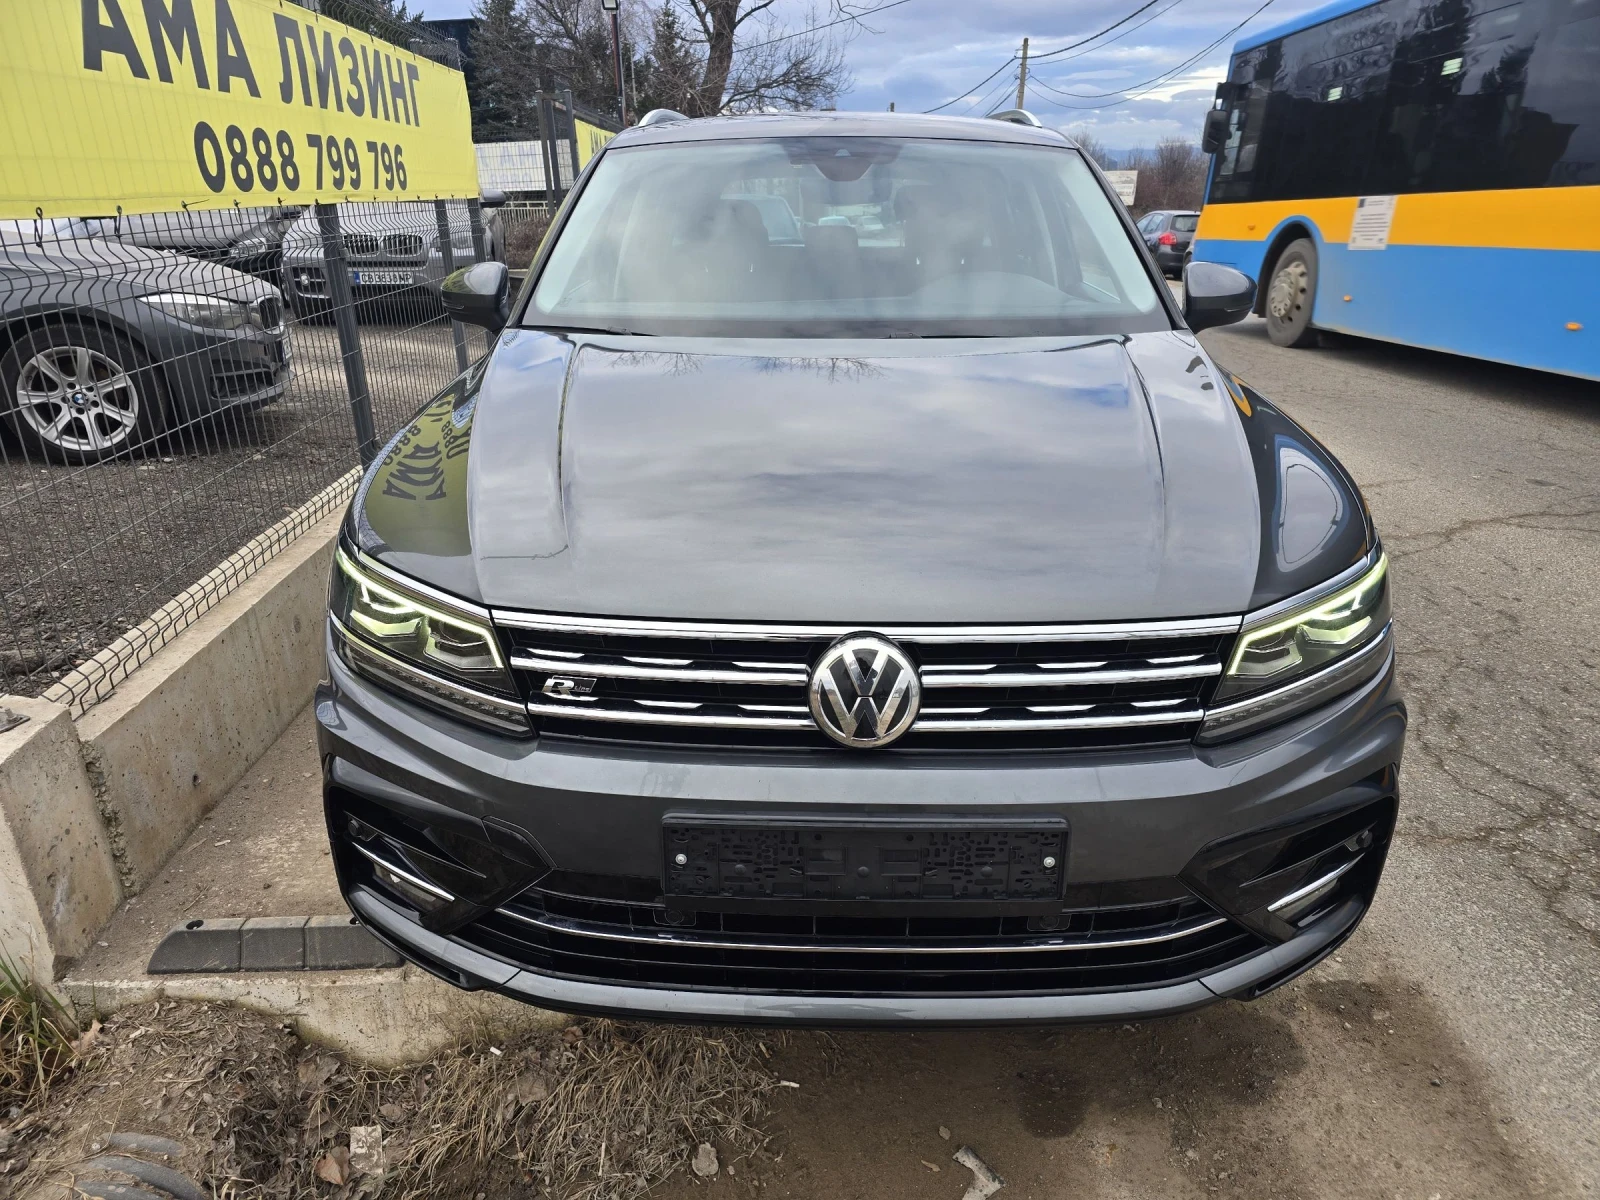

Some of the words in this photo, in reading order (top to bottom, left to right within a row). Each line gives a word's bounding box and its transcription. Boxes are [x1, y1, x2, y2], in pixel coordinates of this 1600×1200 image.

[81, 0, 262, 99] АМА
[272, 12, 421, 128] ЛИЗИНГ
[193, 120, 301, 194] 0888
[306, 133, 362, 191] 799
[366, 140, 408, 192] 796
